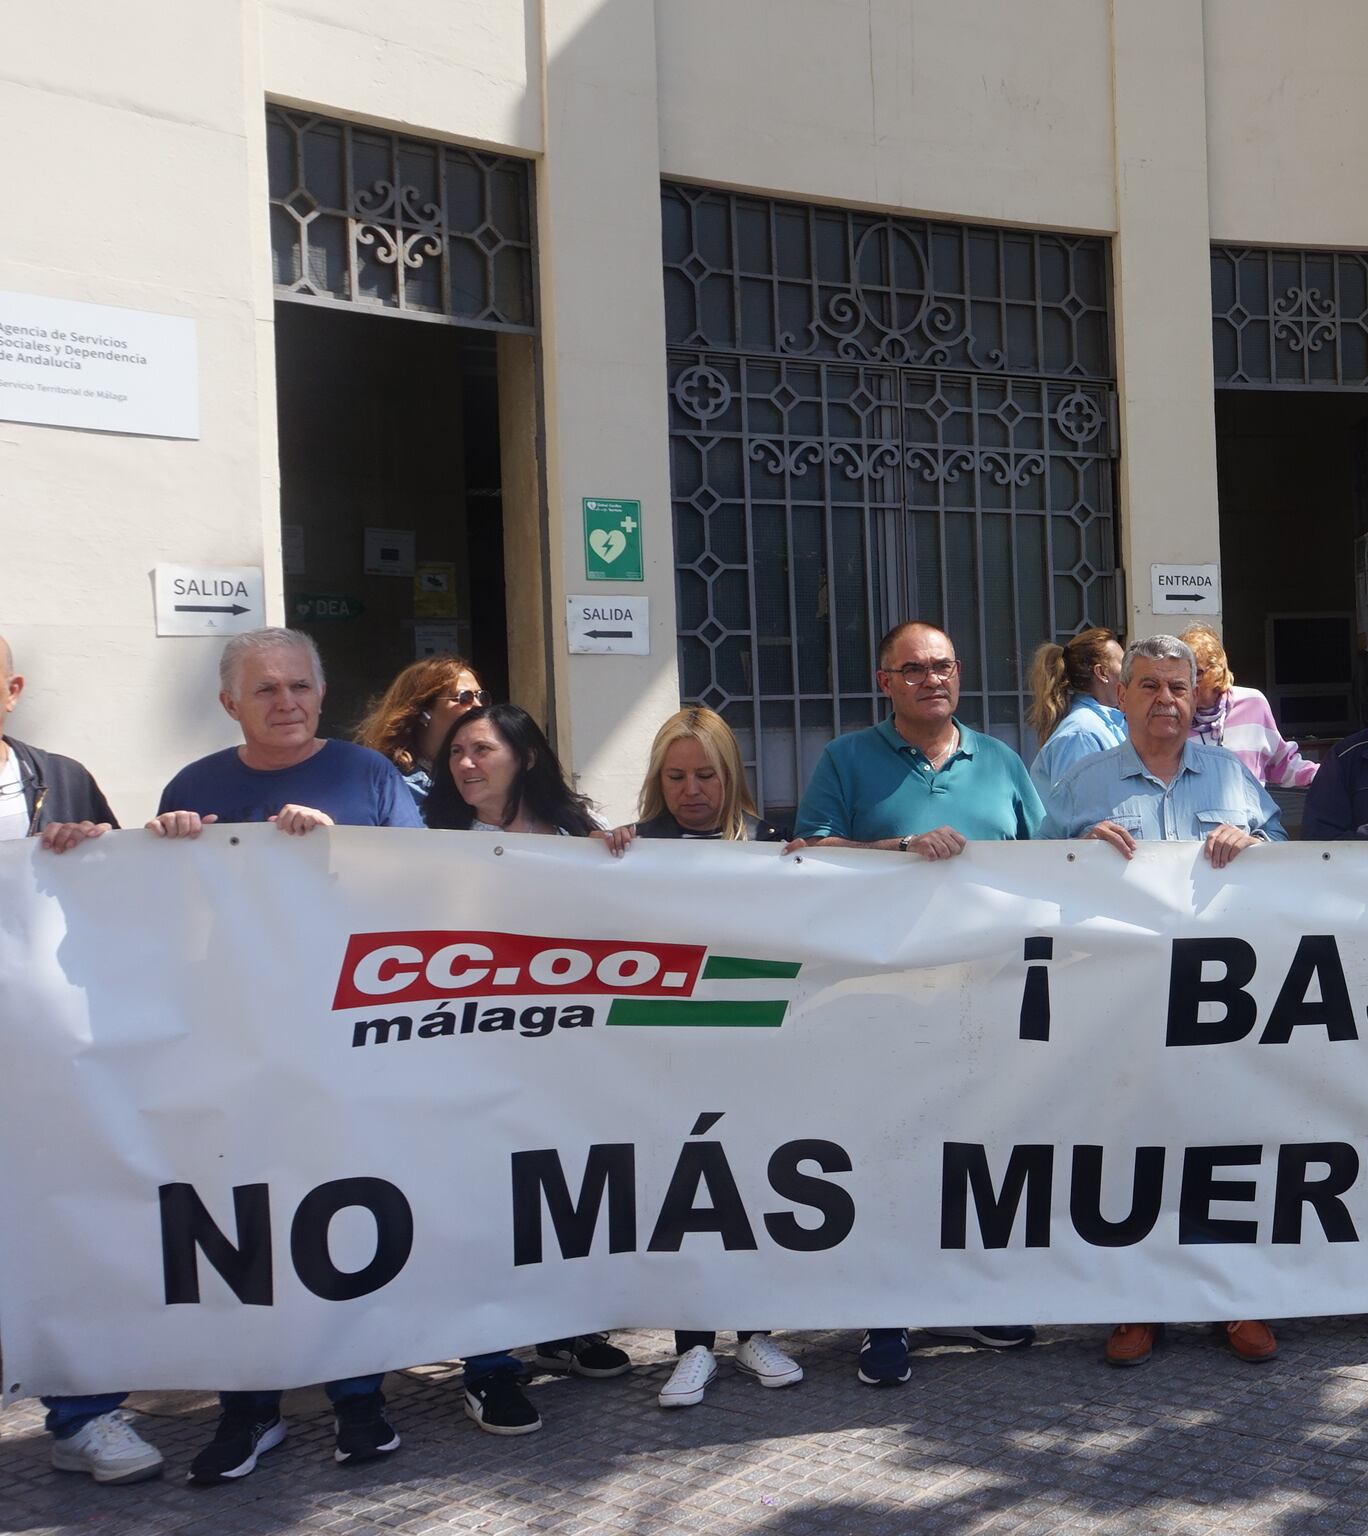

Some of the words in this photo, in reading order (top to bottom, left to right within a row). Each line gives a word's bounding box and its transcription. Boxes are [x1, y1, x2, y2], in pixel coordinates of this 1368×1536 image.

[50, 330, 67, 341] de
[69, 332, 128, 349] Servicios
[16, 353, 82, 370] Andalucía
[54, 345, 61, 355] y
[64, 345, 147, 365] Dependencia
[36, 383, 81, 396] Territorial
[83, 390, 95, 398] de
[96, 391, 128, 402] Málaga
[173, 578, 249, 597] SALIDA
[1158, 575, 1212, 586] ENTRADA
[315, 600, 350, 616] DEA
[582, 607, 633, 621] SALIDA
[351, 1001, 595, 1048] málaga
[159, 1176, 414, 1307] NO
[512, 1112, 856, 1267] MÁS
